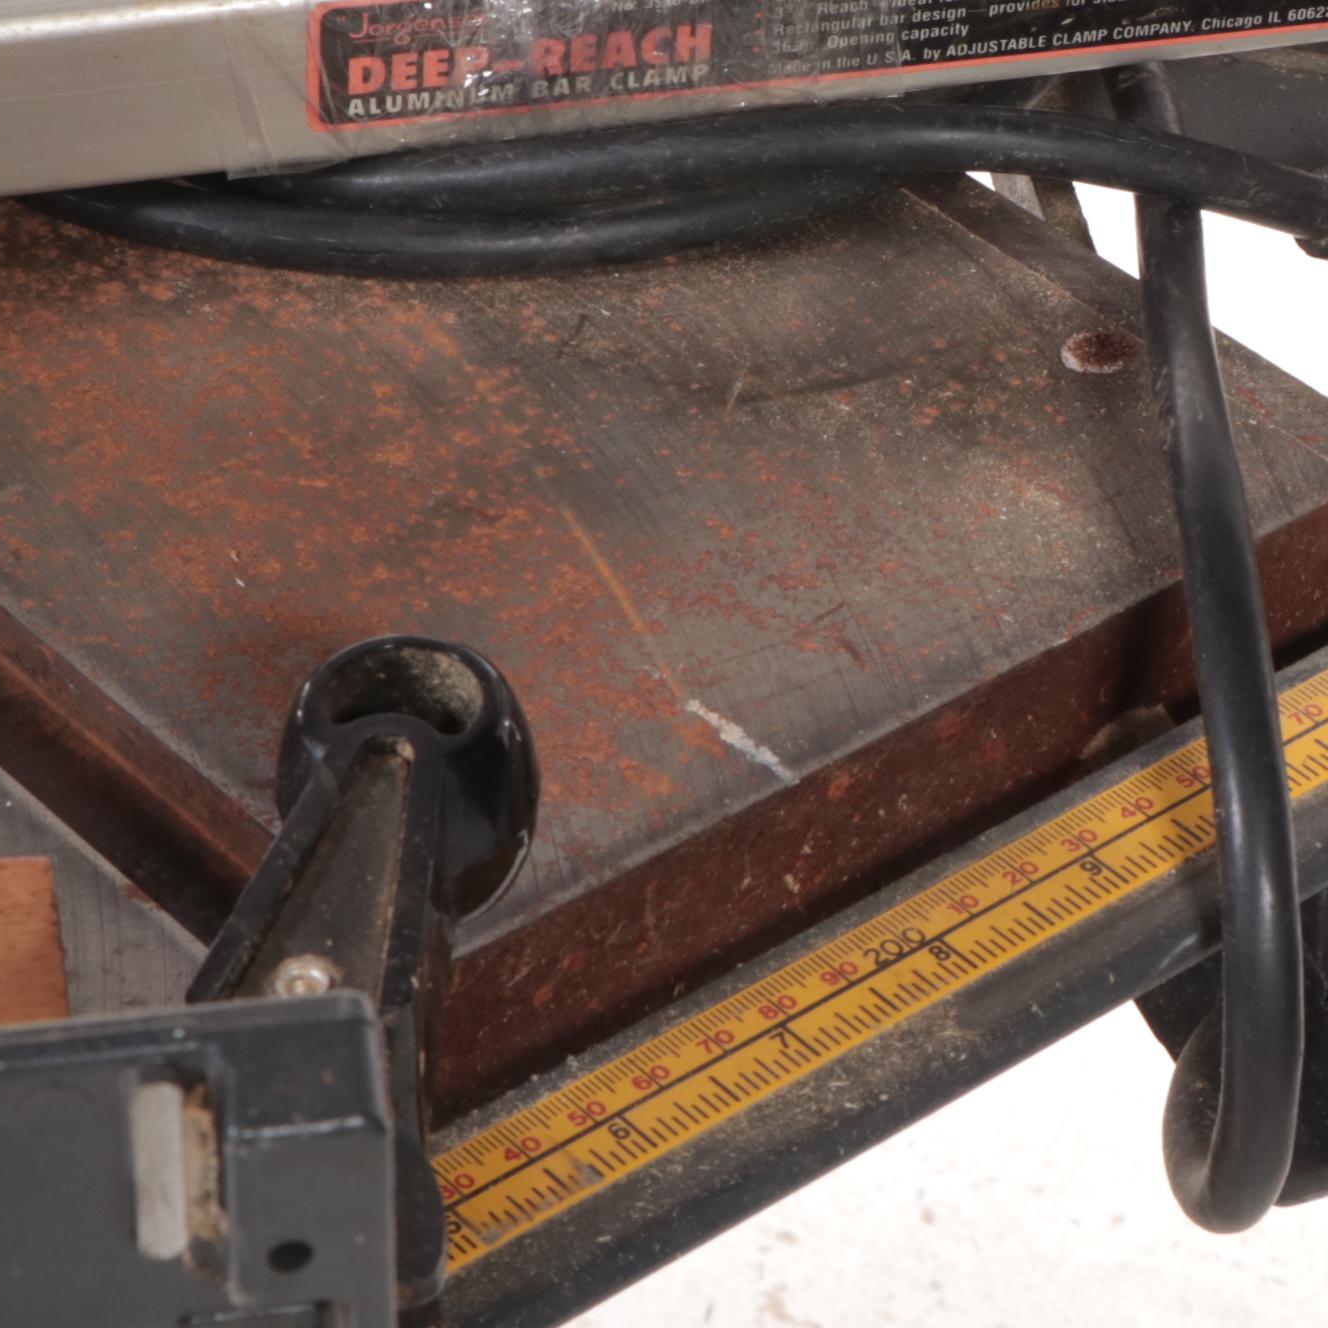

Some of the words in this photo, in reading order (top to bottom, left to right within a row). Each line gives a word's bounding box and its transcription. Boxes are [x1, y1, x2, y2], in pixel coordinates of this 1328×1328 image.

[774, 13, 873, 37] Rectangular
[879, 11, 905, 27] bar
[826, 30, 896, 50] Opening
[901, 22, 970, 43] capacity
[837, 54, 861, 69] the
[923, 46, 942, 63] by
[945, 34, 1047, 57] ADJUSTABLE
[1052, 27, 1109, 47] CLAMP
[1201, 13, 1263, 32] Chicago
[1267, 9, 1283, 23] IL
[348, 23, 713, 96] DEEP-REACH
[531, 75, 593, 99] BAR
[610, 63, 711, 91] CLAMP
[1286, 702, 1324, 727] 70
[502, 1135, 543, 1163] 40
[566, 1100, 608, 1128] 50
[631, 1064, 671, 1092] 60
[695, 1028, 736, 1056] 70
[756, 994, 798, 1022] 80
[819, 960, 859, 987] 90
[863, 926, 927, 968] 200
[946, 894, 981, 917] 10
[1002, 860, 1040, 887] 20
[1059, 827, 1099, 854] 30
[1119, 795, 1155, 821] 40
[1175, 764, 1212, 789] 50
[606, 1116, 633, 1141] 6
[769, 1029, 790, 1051] 7
[927, 940, 953, 963] 8
[1078, 859, 1105, 877] 9
